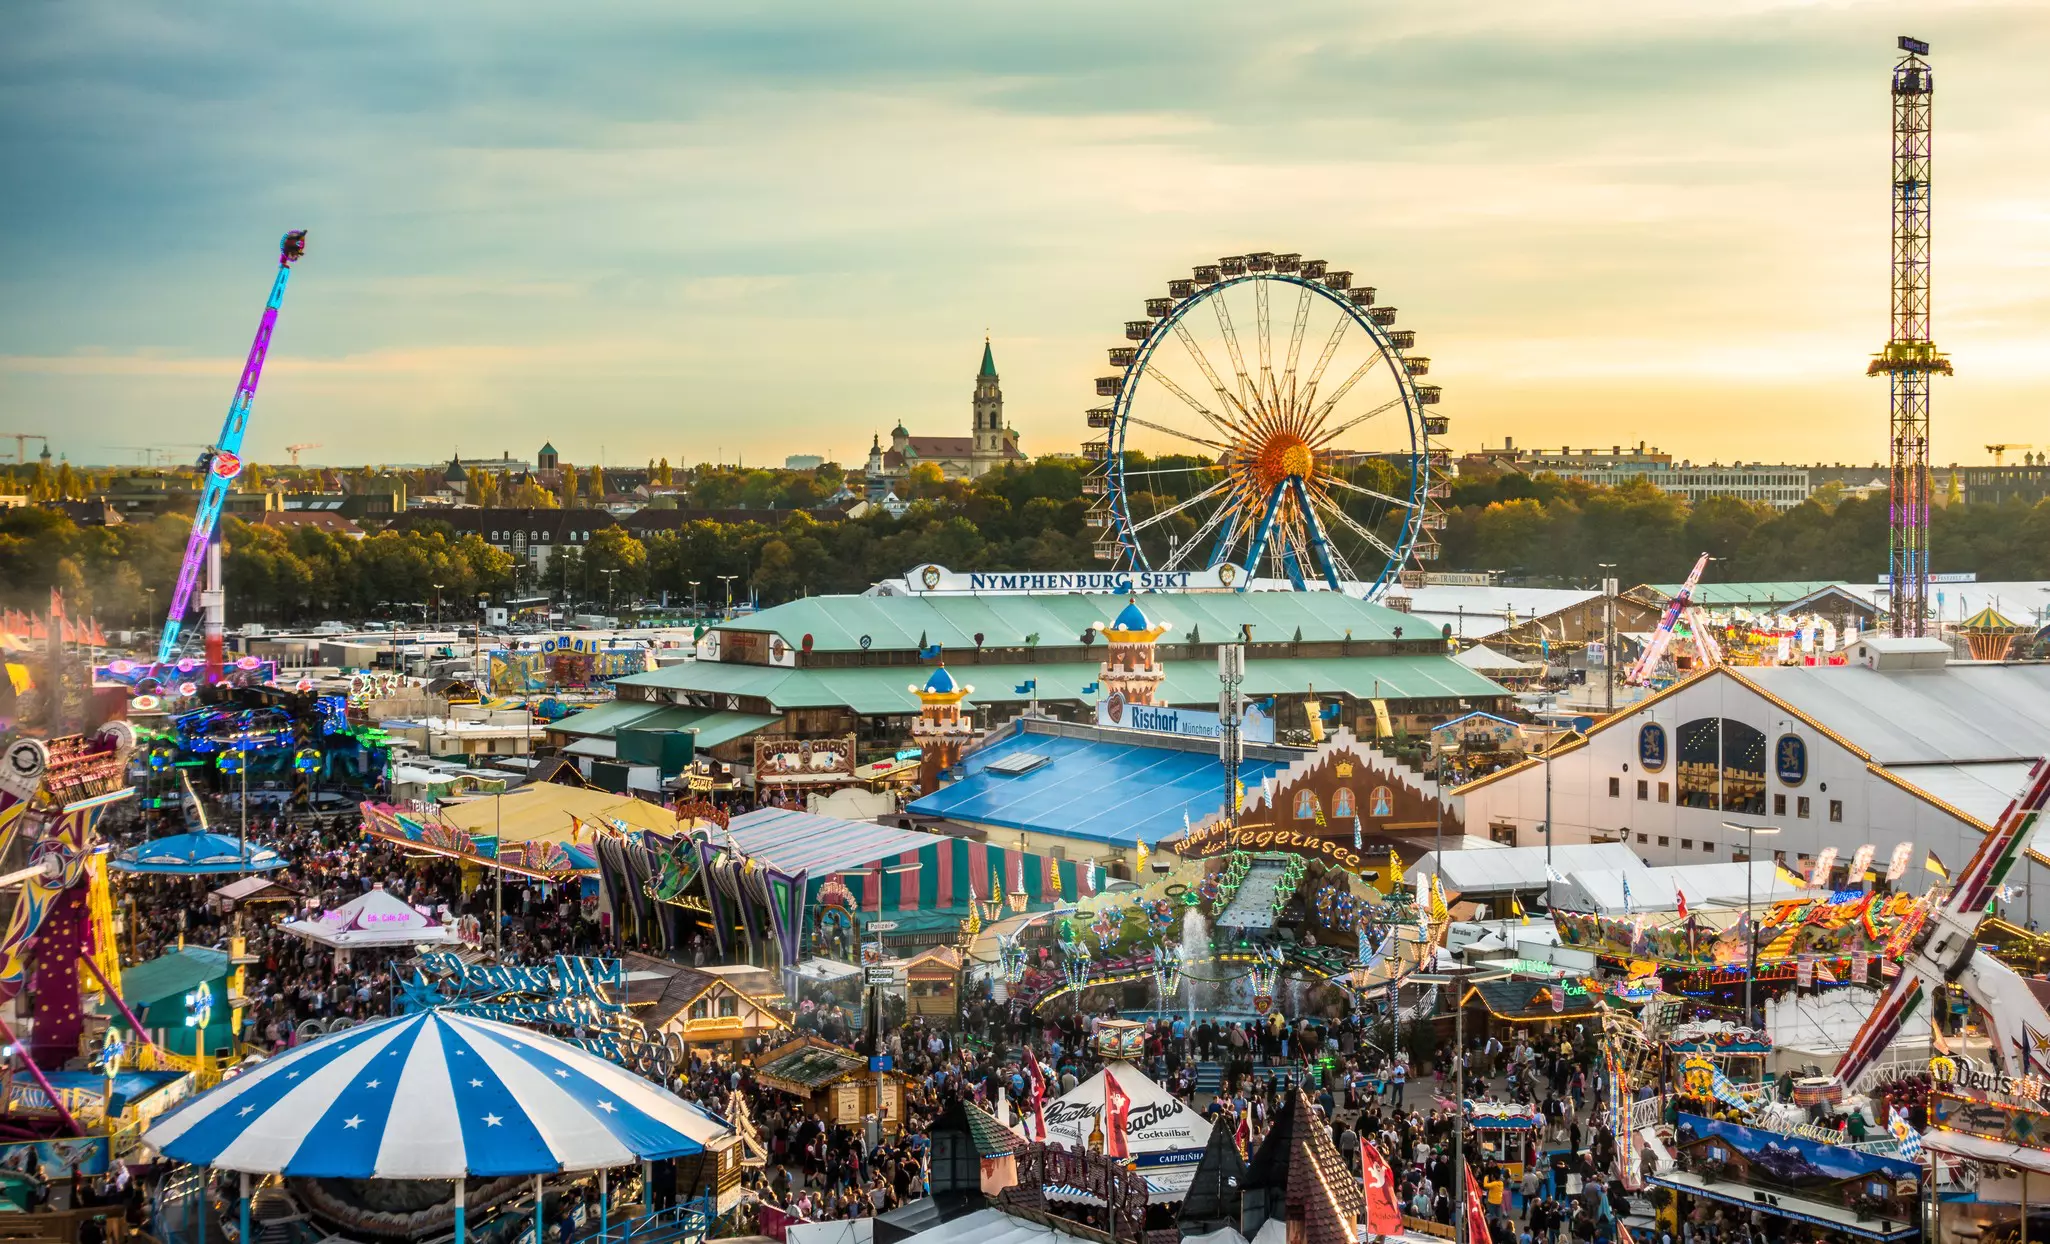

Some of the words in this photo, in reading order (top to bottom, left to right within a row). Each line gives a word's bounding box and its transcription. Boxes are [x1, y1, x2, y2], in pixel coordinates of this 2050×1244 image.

[970, 573, 1130, 590] NYMPHENBURG
[1141, 572, 1191, 588] SEKT
[1440, 574, 1473, 584] TRADITION
[1131, 706, 1179, 733] Rischart
[1182, 722, 1214, 736] Münchner
[763, 741, 800, 761] CIRCUS
[812, 740, 849, 758] CIRCUS
[1174, 832, 1206, 855] RUND
[1211, 817, 1233, 835] UM
[1229, 822, 1361, 867] Tegernsee
[1126, 1099, 1184, 1136] eaches
[1137, 1129, 1191, 1141] Cocktailbar
